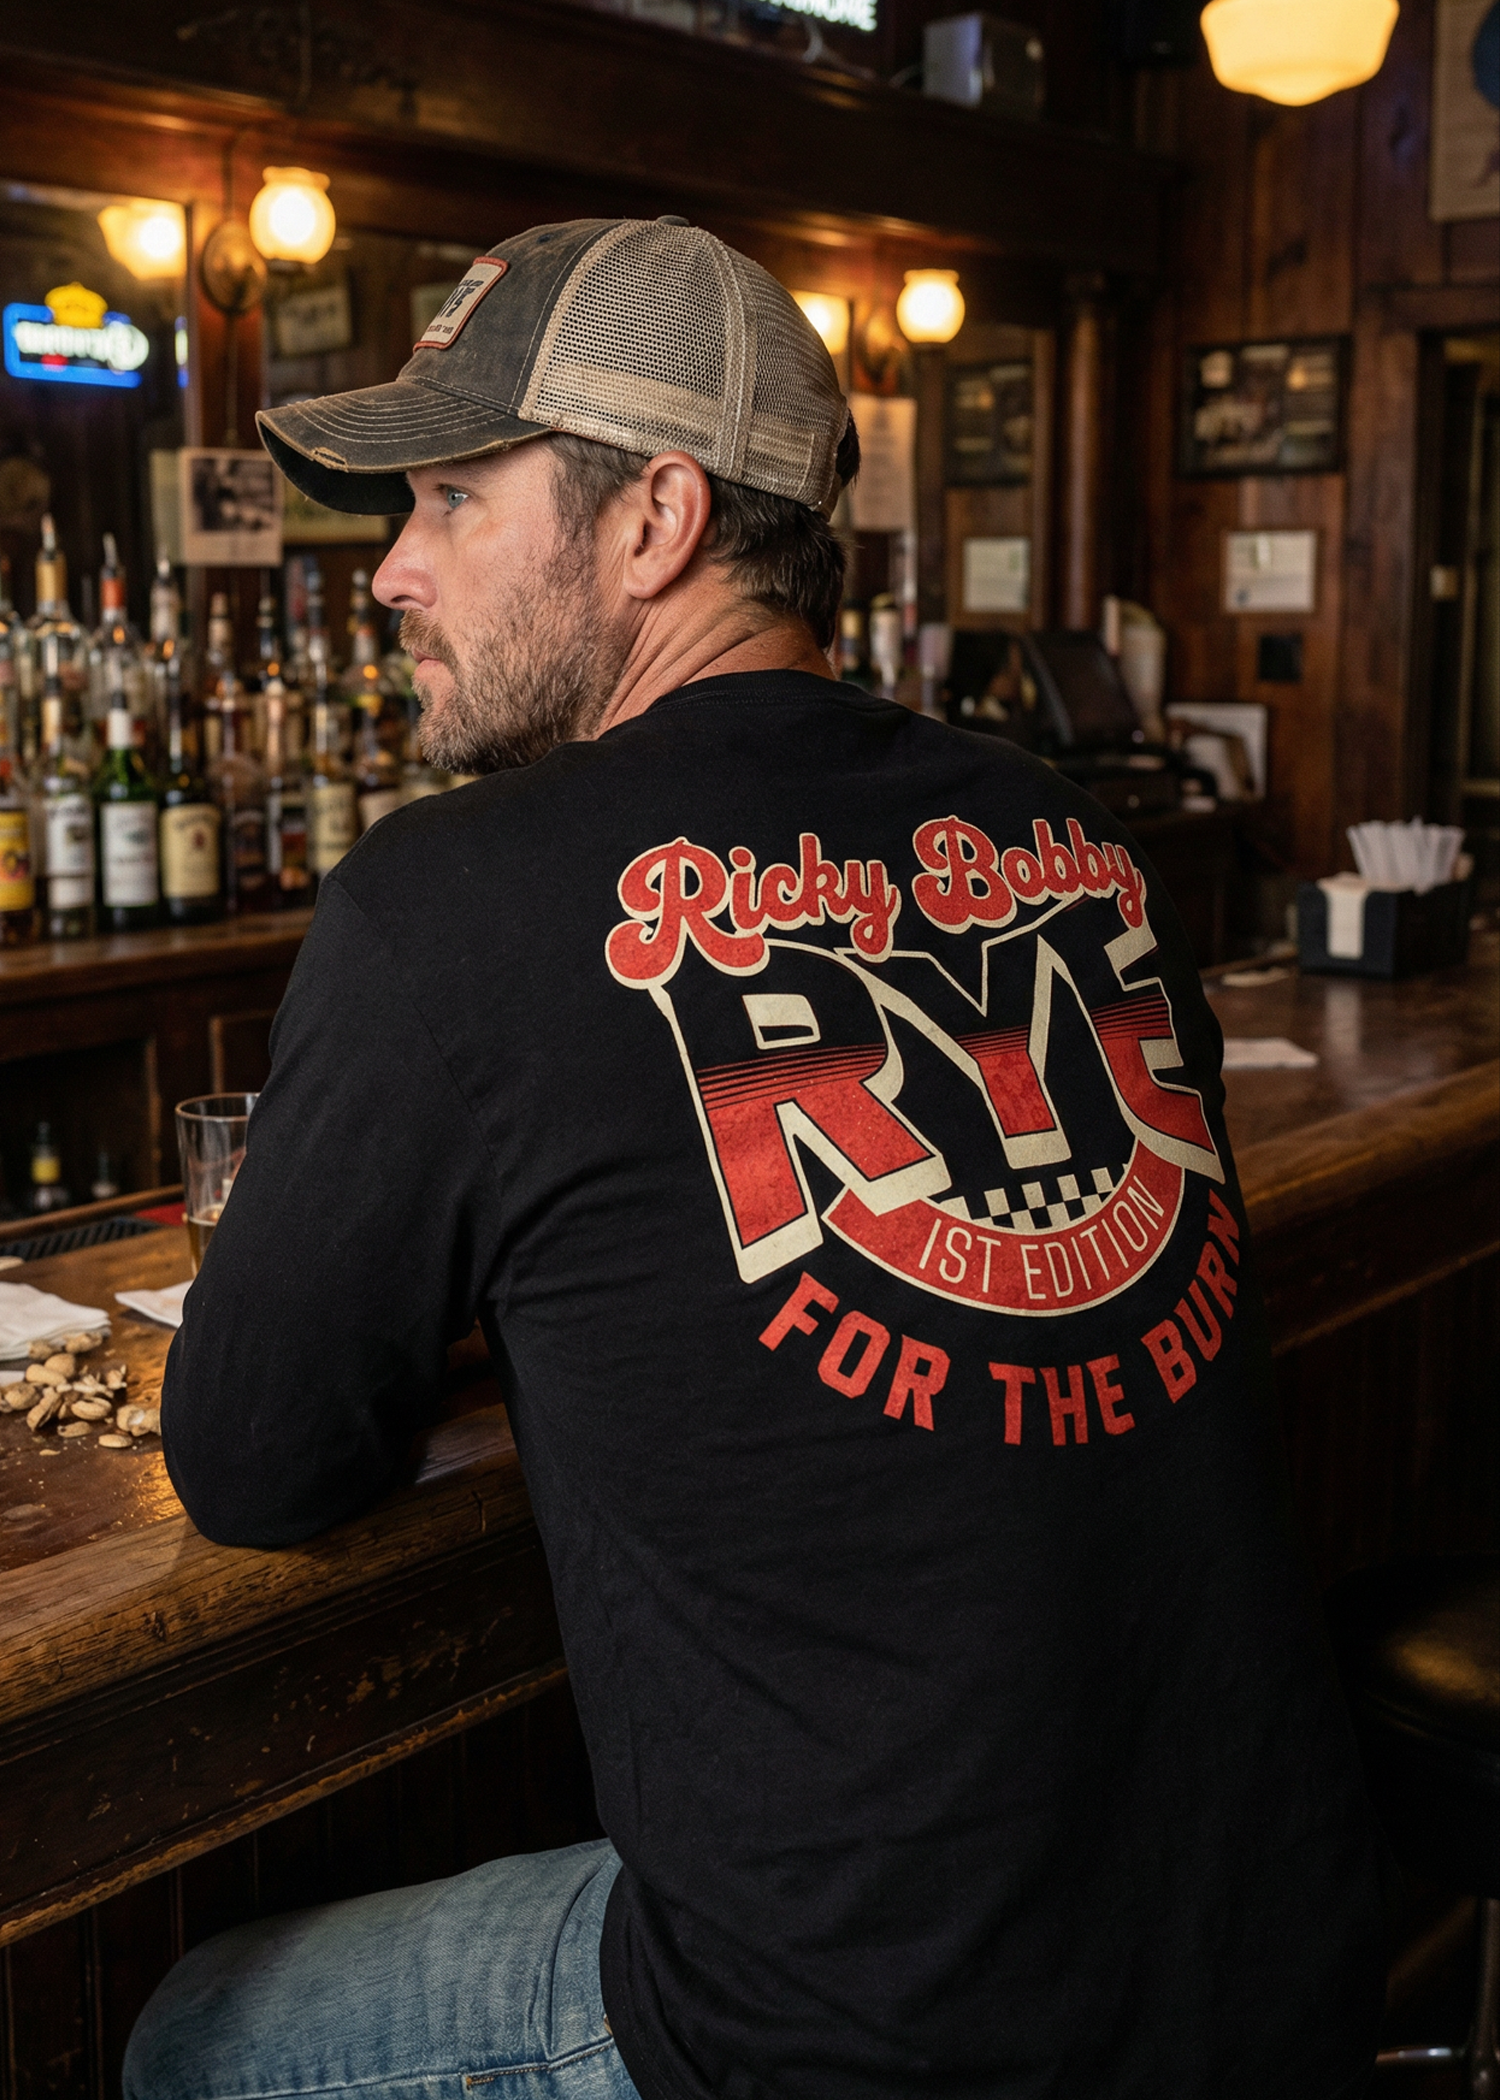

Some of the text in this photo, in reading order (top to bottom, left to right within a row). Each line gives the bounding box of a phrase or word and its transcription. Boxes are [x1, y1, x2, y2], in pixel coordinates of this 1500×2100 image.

[605, 815, 1147, 990] Ricky Bobby
[648, 910, 1226, 1284] RYE
[757, 1189, 1241, 1447] FOR THE BURN
[1020, 1174, 1165, 1300] EDITION
